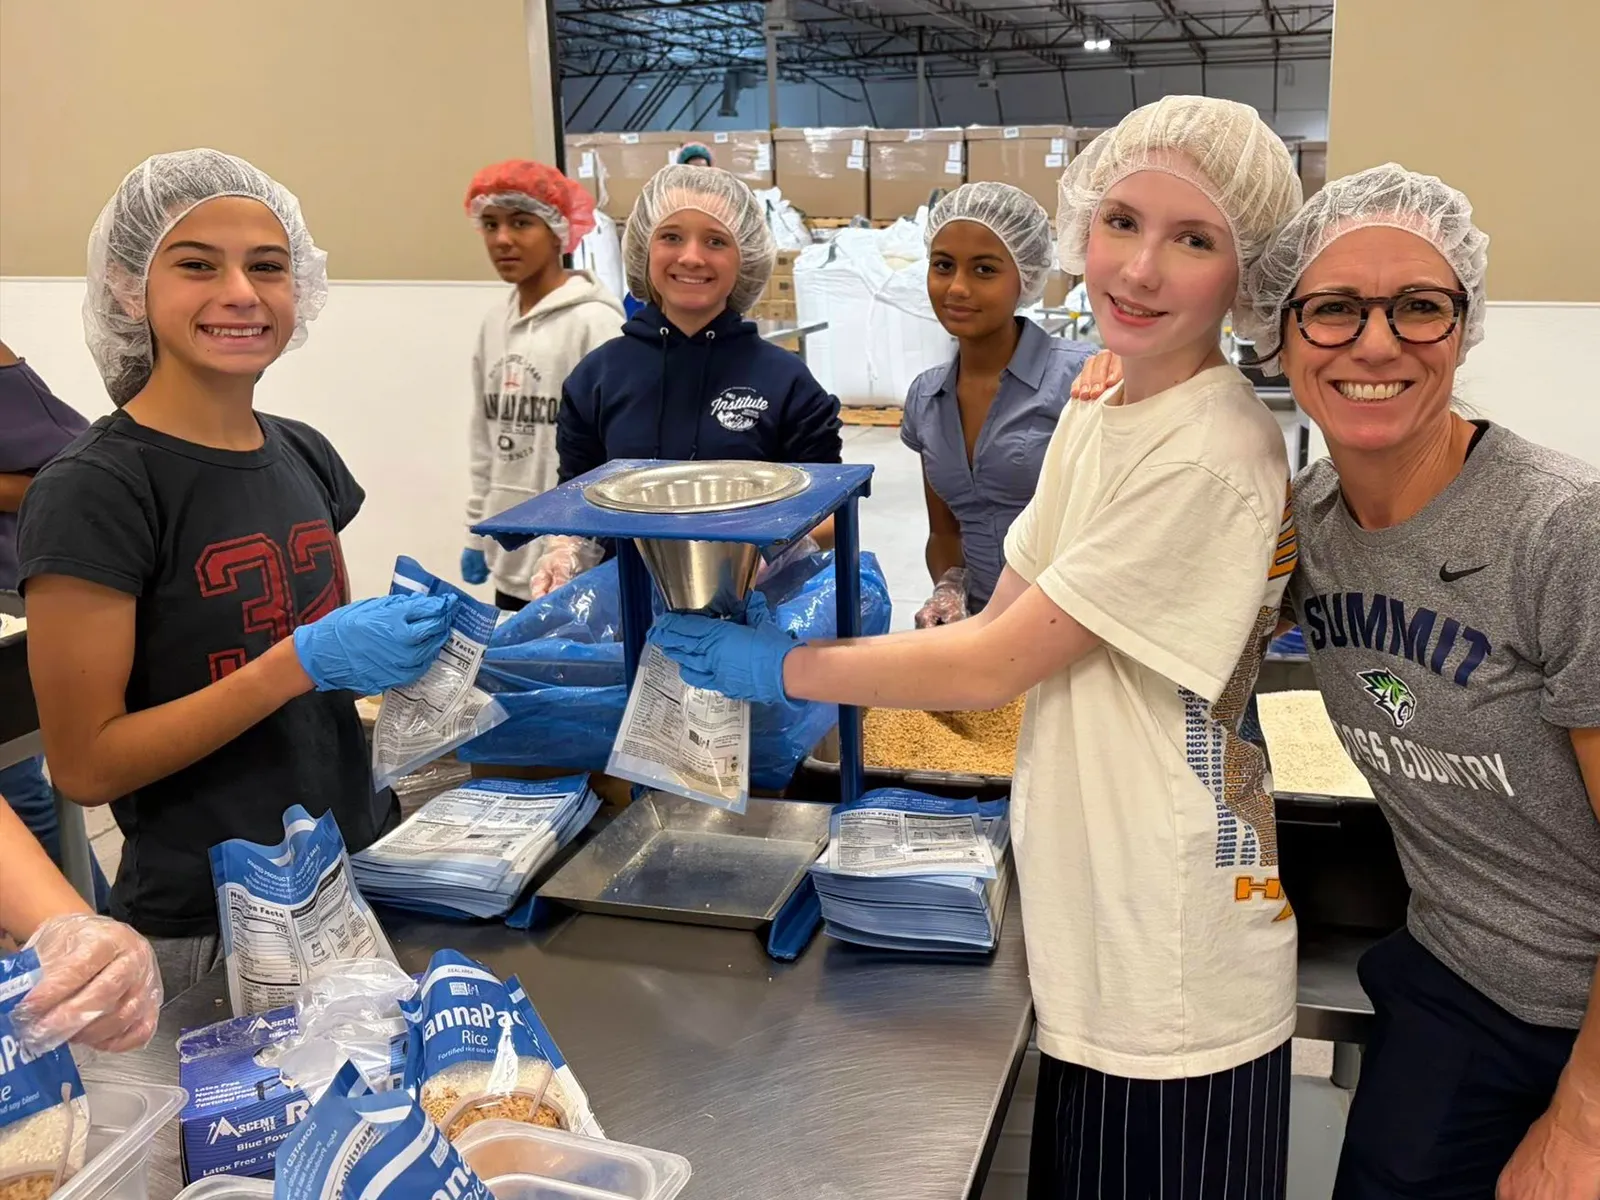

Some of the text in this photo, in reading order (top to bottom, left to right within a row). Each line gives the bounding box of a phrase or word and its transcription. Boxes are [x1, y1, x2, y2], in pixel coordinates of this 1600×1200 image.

[711, 395, 769, 416] Institute
[1304, 592, 1493, 688] SUMMIT
[1390, 736, 1515, 797] COUNTRY
[260, 907, 285, 919] Facts
[425, 1003, 525, 1041] annaPac
[462, 1030, 489, 1046] Rice
[438, 1045, 465, 1061] Fortified
[22, 1091, 40, 1106] blend
[195, 1085, 219, 1093] Latex
[237, 1132, 293, 1151] Blue Pow
[203, 1156, 257, 1177] Latex Free
